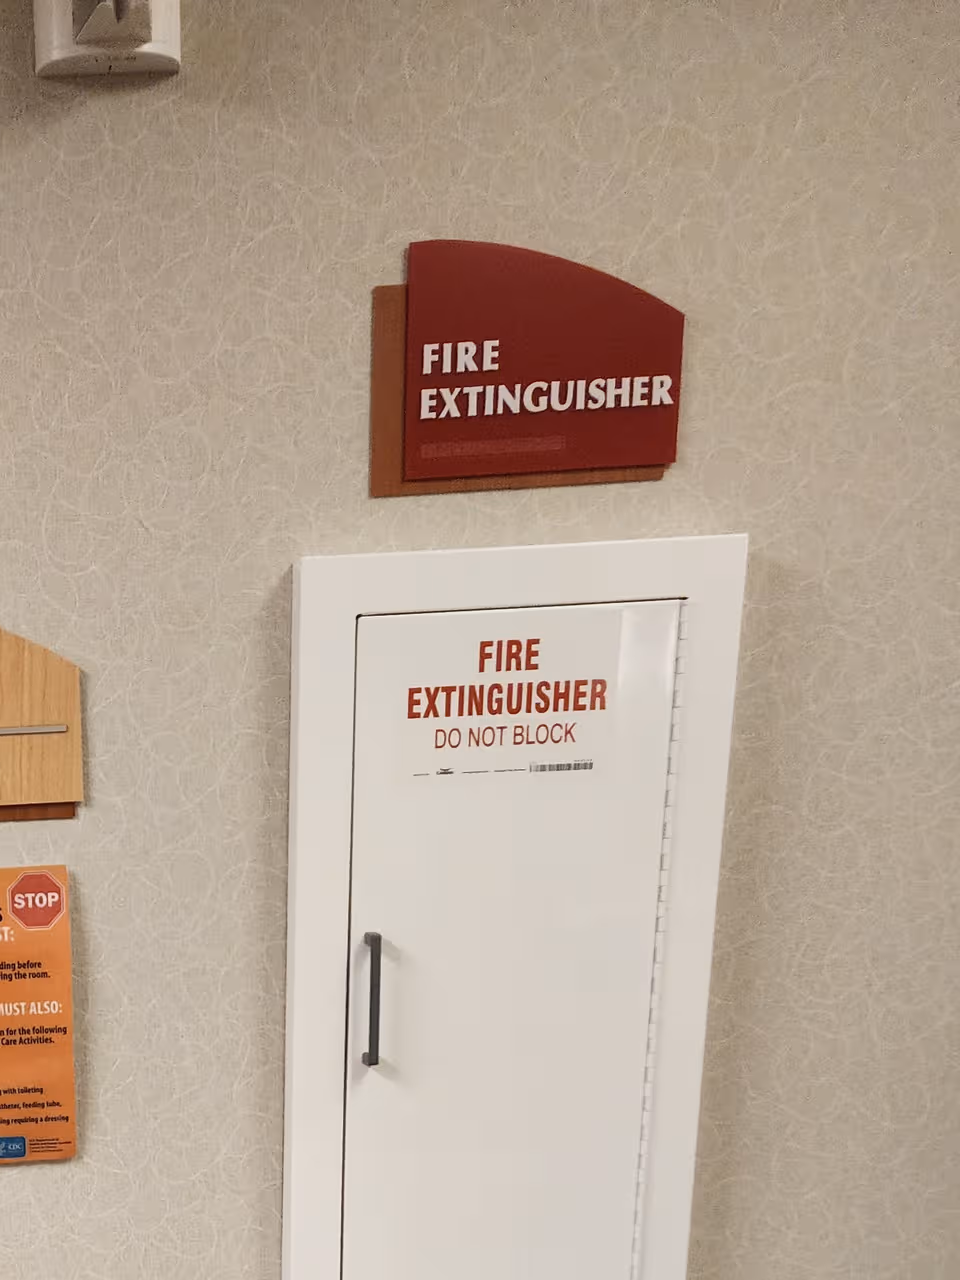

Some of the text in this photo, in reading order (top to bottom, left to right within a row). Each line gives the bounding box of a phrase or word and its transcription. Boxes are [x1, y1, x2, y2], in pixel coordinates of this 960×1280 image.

[422, 339, 501, 375] FIRE
[419, 374, 674, 420] EXTINGUISHER
[479, 638, 540, 673] FIRE
[407, 679, 608, 719] EXTINGUISHER
[435, 722, 577, 749] DO NOT BLOCK
[14, 892, 59, 908] STOP
[17, 961, 41, 969] before
[14, 971, 27, 979] the
[29, 1001, 62, 1014] ALSO:
[6, 1027, 17, 1035] for
[18, 1026, 31, 1035] the
[32, 1026, 67, 1034] following
[1, 1037, 17, 1045] Care
[17, 1087, 43, 1095] toileting
[22, 1101, 45, 1109] feeding
[46, 1100, 62, 1108] tube,
[11, 1117, 38, 1125] requiring
[44, 1115, 69, 1123] dressing
